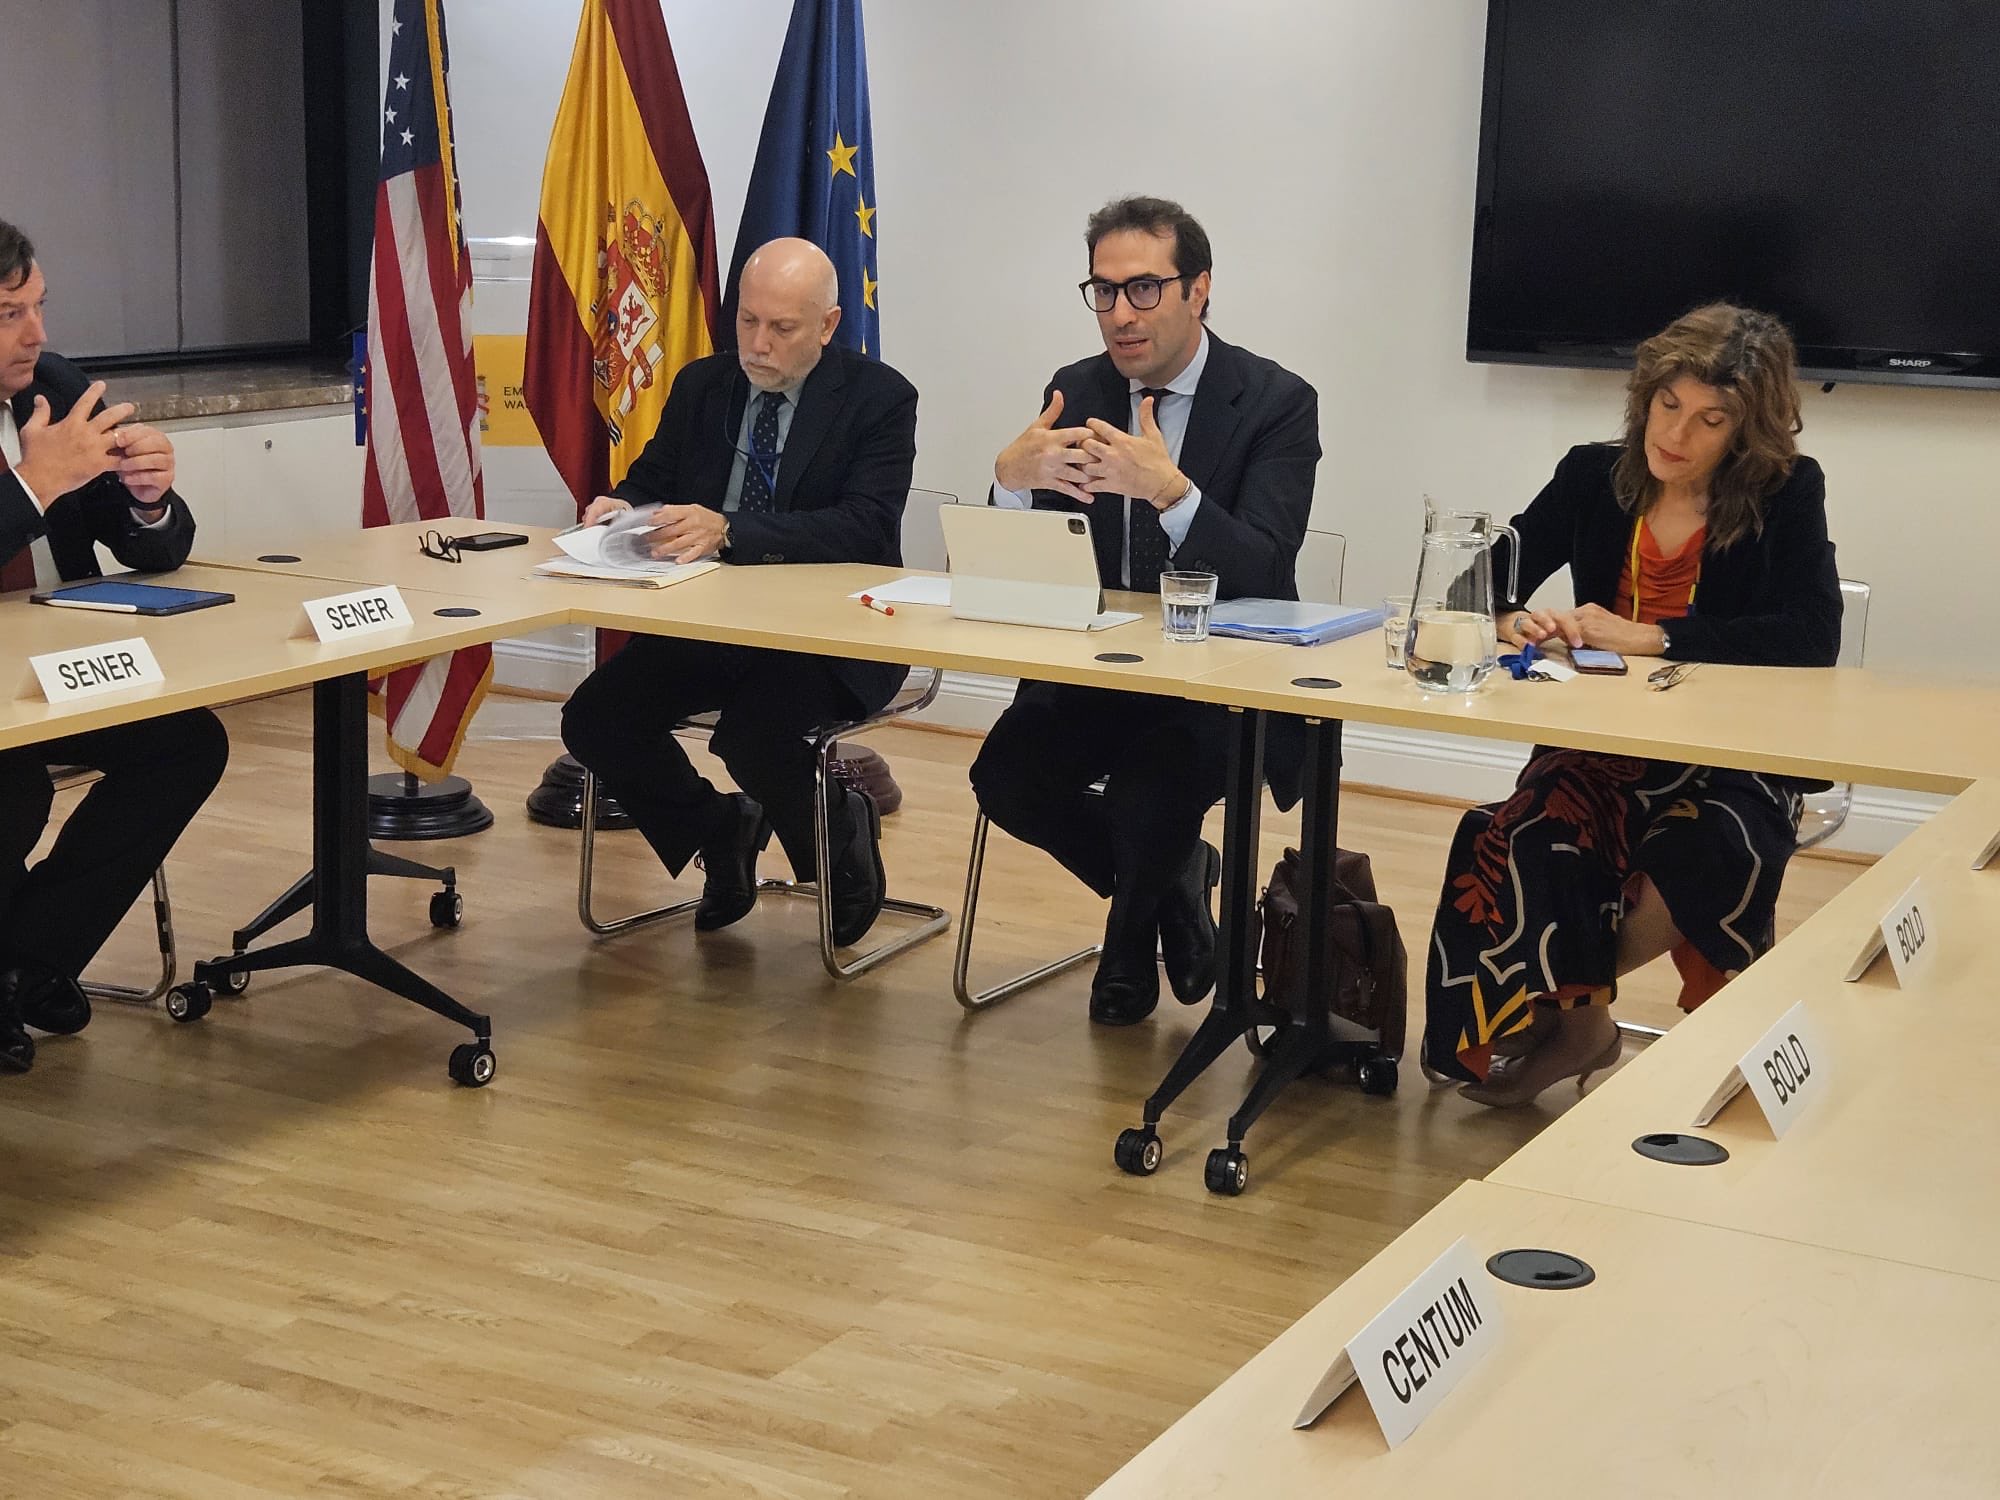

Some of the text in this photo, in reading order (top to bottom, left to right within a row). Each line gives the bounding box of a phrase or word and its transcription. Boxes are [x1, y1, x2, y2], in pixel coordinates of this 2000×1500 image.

[1889, 358, 1931, 368] SHARP
[326, 597, 394, 631] SENER
[57, 651, 142, 691] SENER
[1895, 905, 1925, 964] BOLD
[1763, 1033, 1811, 1106] BOLD
[1382, 1276, 1483, 1404] CENTUM
